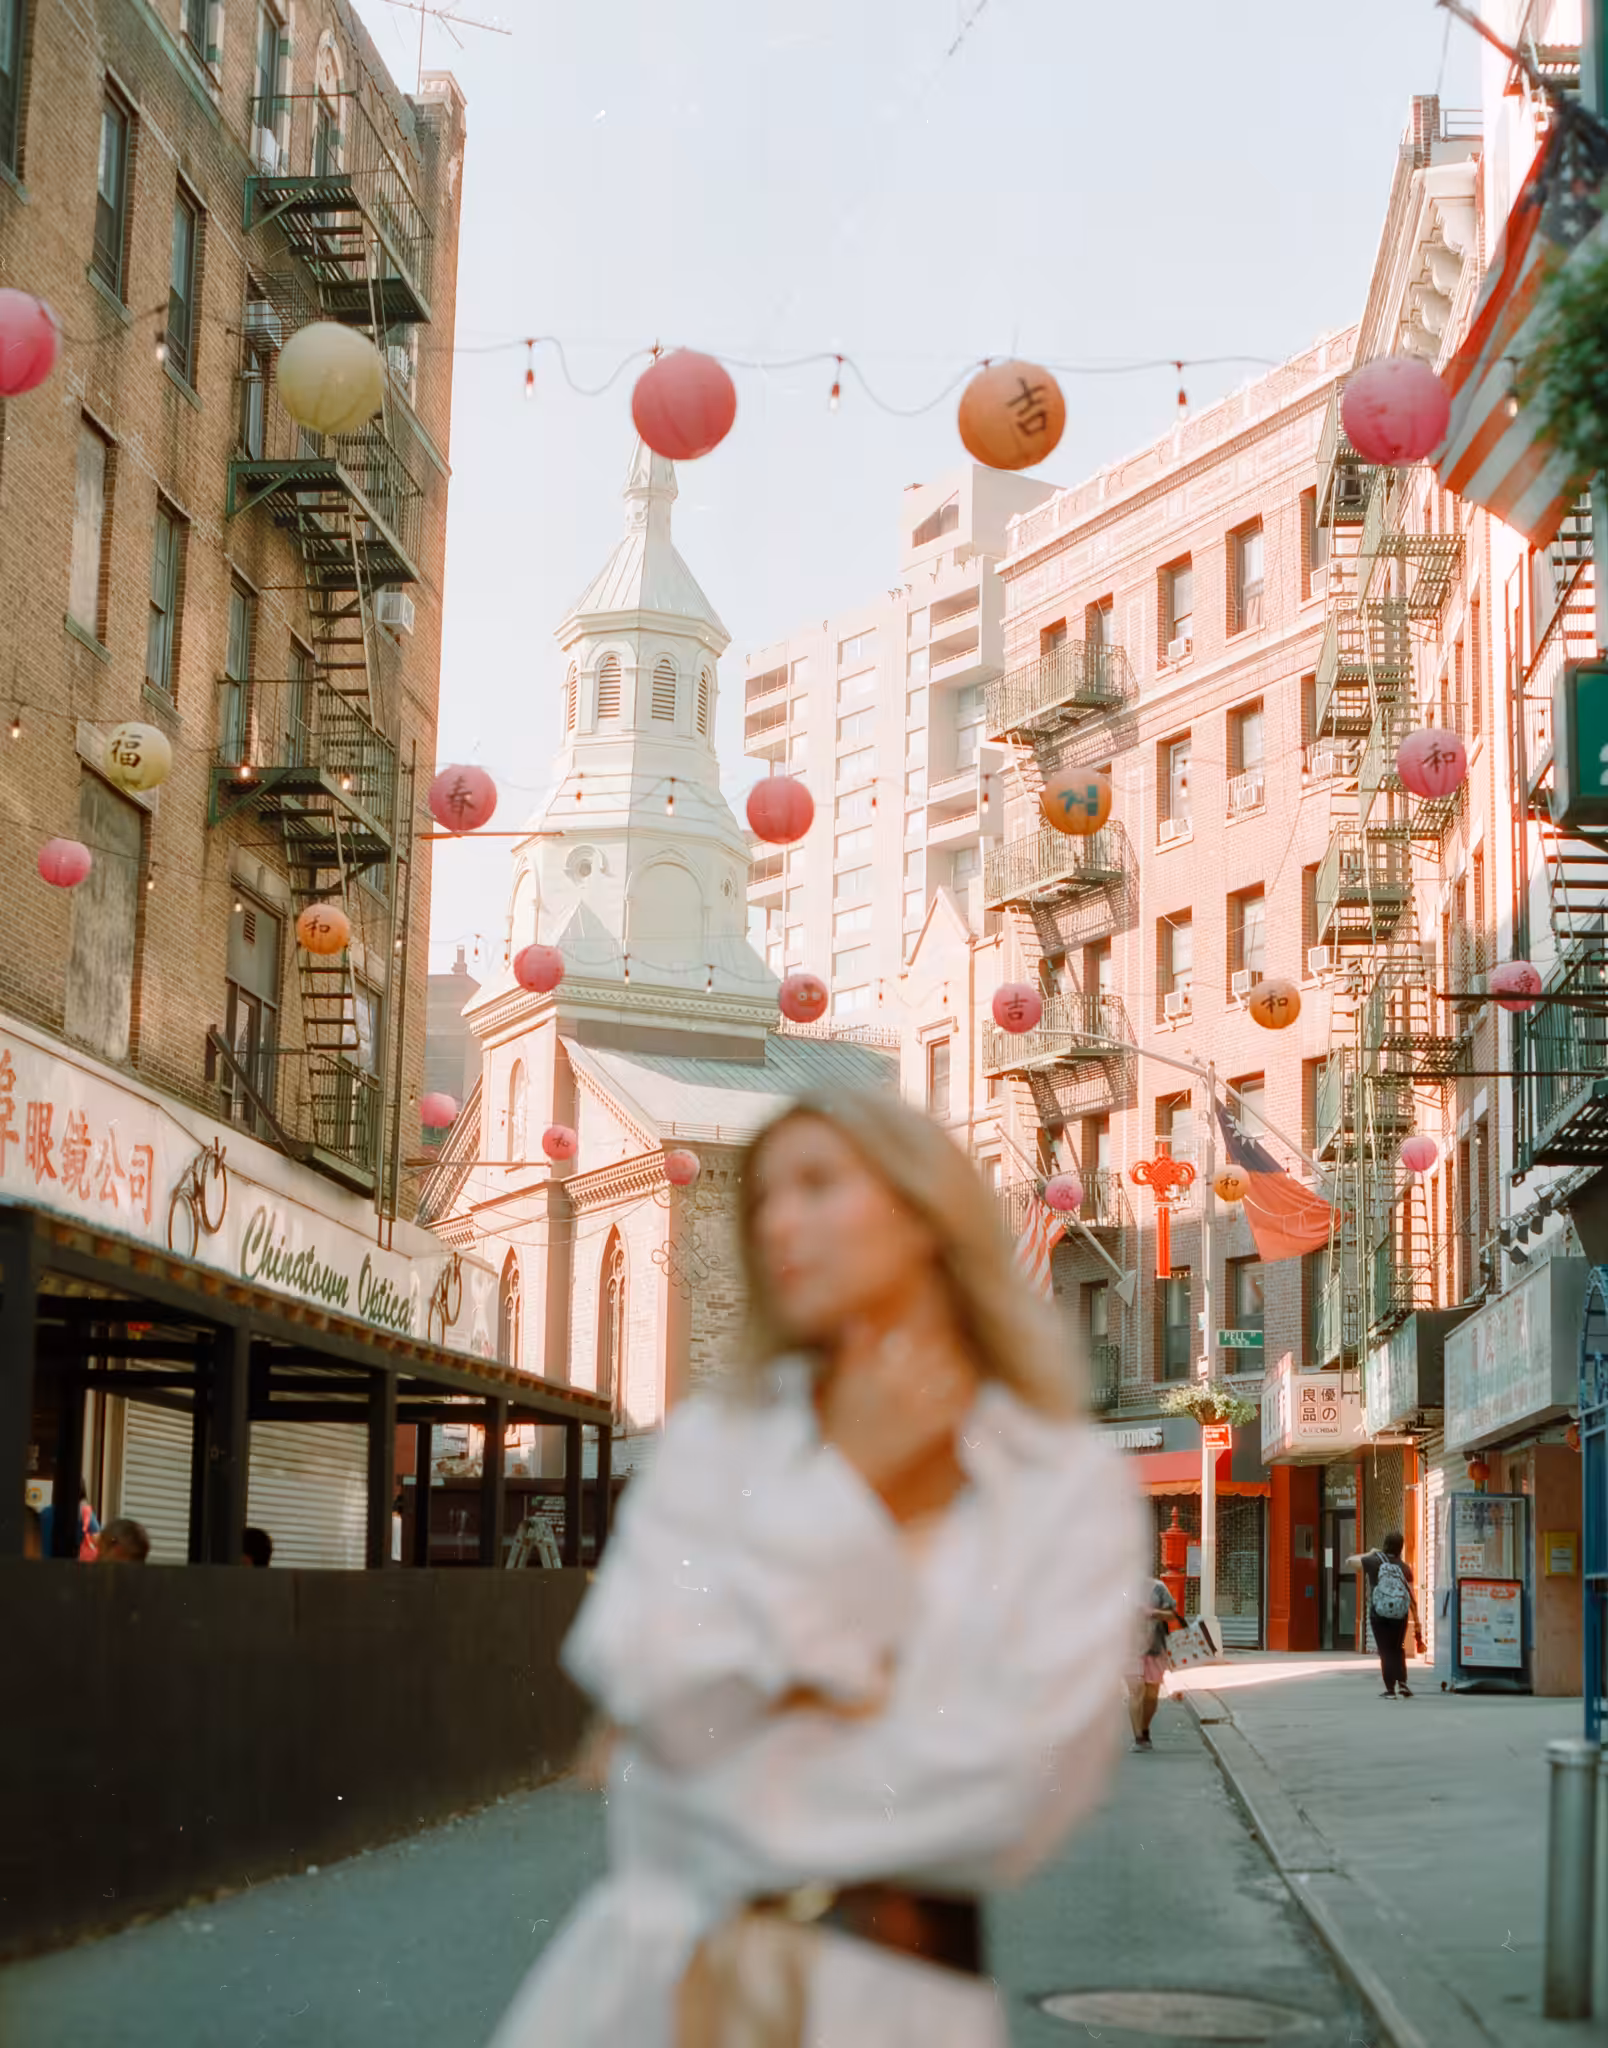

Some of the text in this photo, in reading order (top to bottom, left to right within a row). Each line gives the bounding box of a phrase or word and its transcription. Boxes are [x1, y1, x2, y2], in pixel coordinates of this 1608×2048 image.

[1006, 377, 1047, 436] 吉
[111, 731, 142, 768] 福
[1421, 742, 1456, 774] 和
[304, 914, 330, 938] 和
[1002, 993, 1028, 1021] 吉
[1260, 990, 1288, 1014] 和
[1220, 1172, 1239, 1190] 和
[240, 1205, 349, 1309] Chinatown
[1224, 1332, 1246, 1341] PELL
